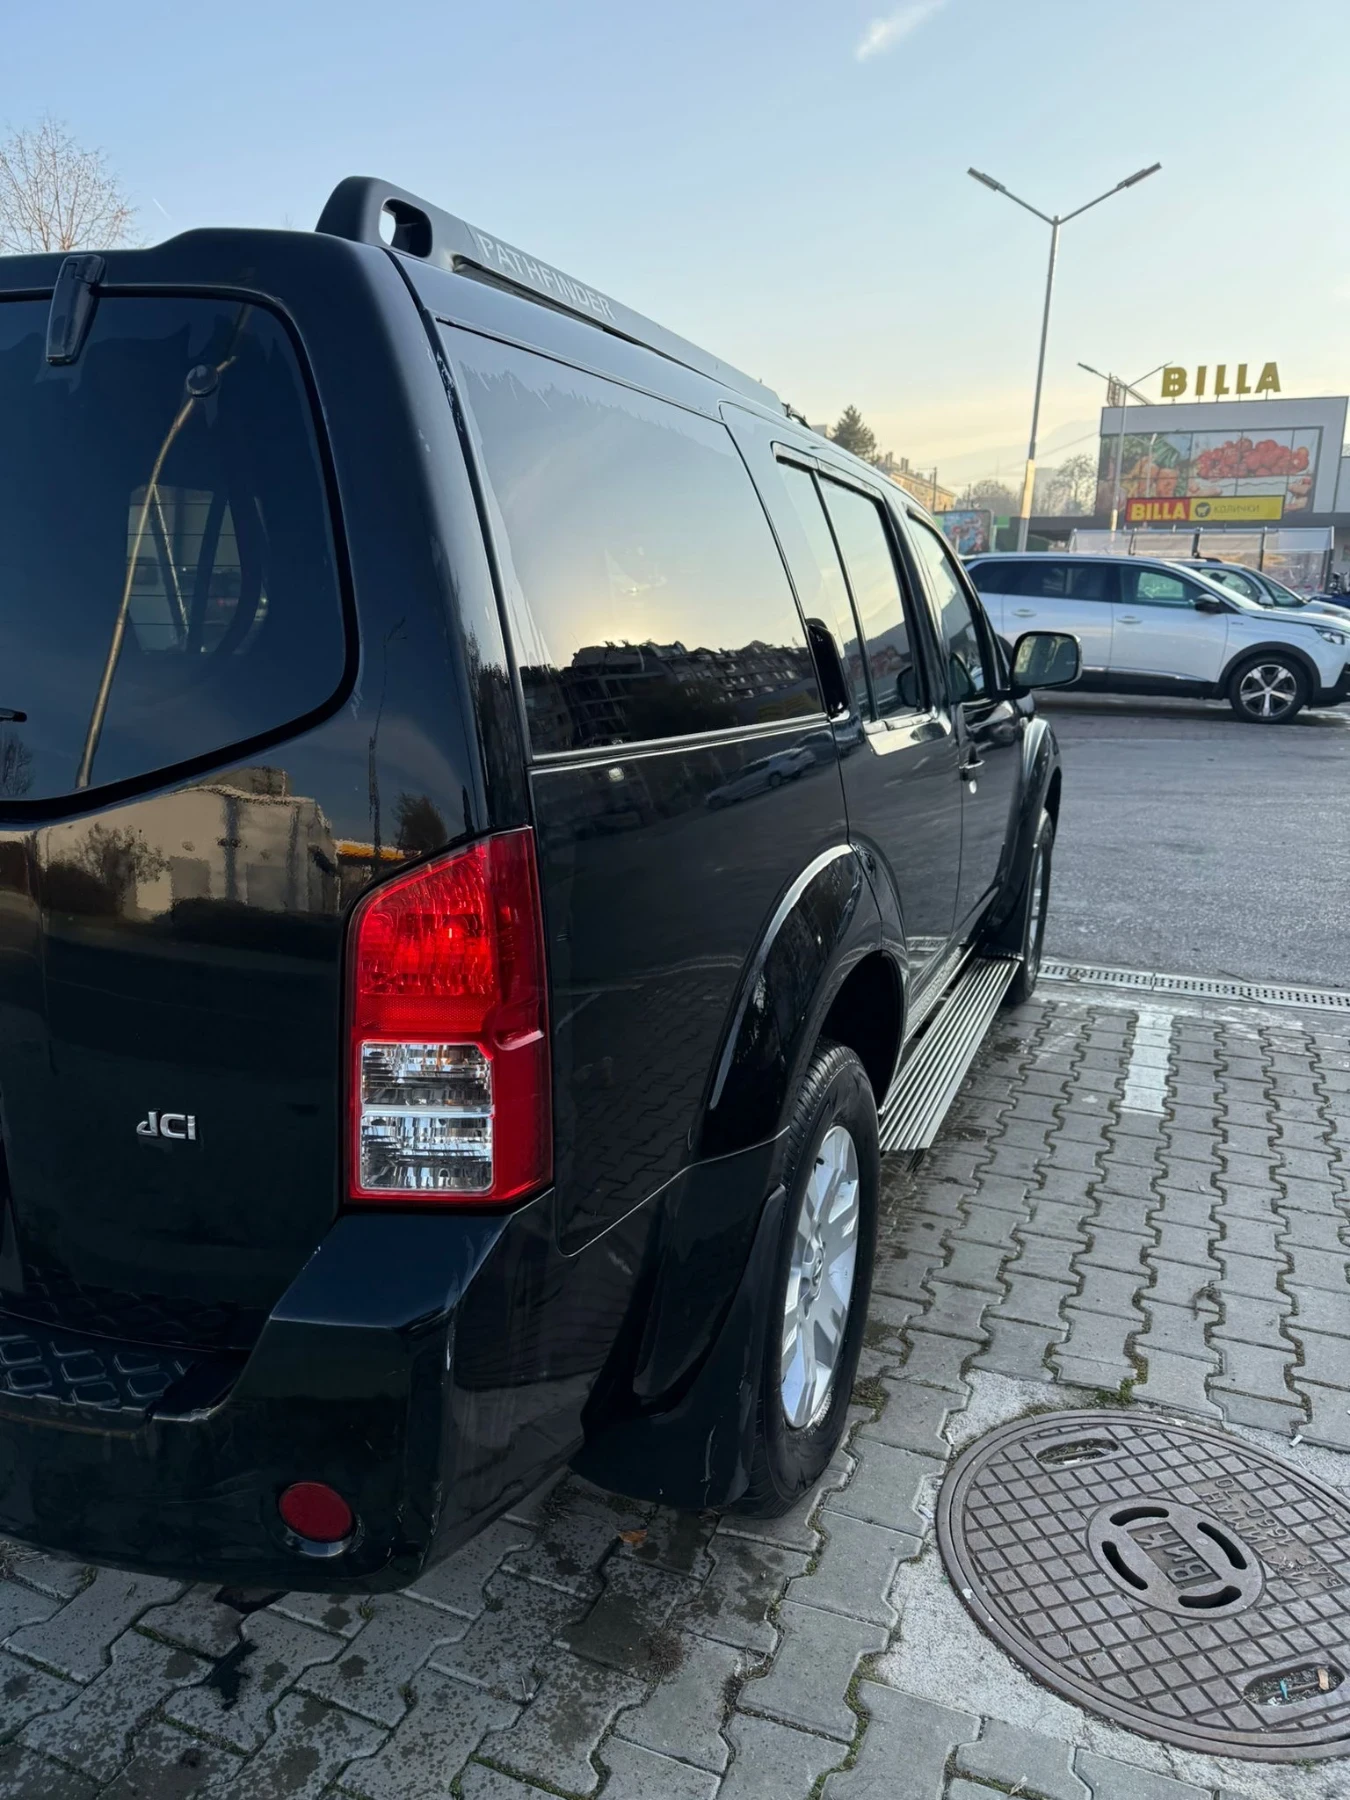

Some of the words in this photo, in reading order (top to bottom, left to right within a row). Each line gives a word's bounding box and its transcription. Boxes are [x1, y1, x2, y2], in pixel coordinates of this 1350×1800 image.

[477, 232, 617, 321] PATHFINDER
[1161, 362, 1281, 397] BILLA
[1130, 501, 1187, 521] BILLA
[136, 1111, 196, 1140] dCi
